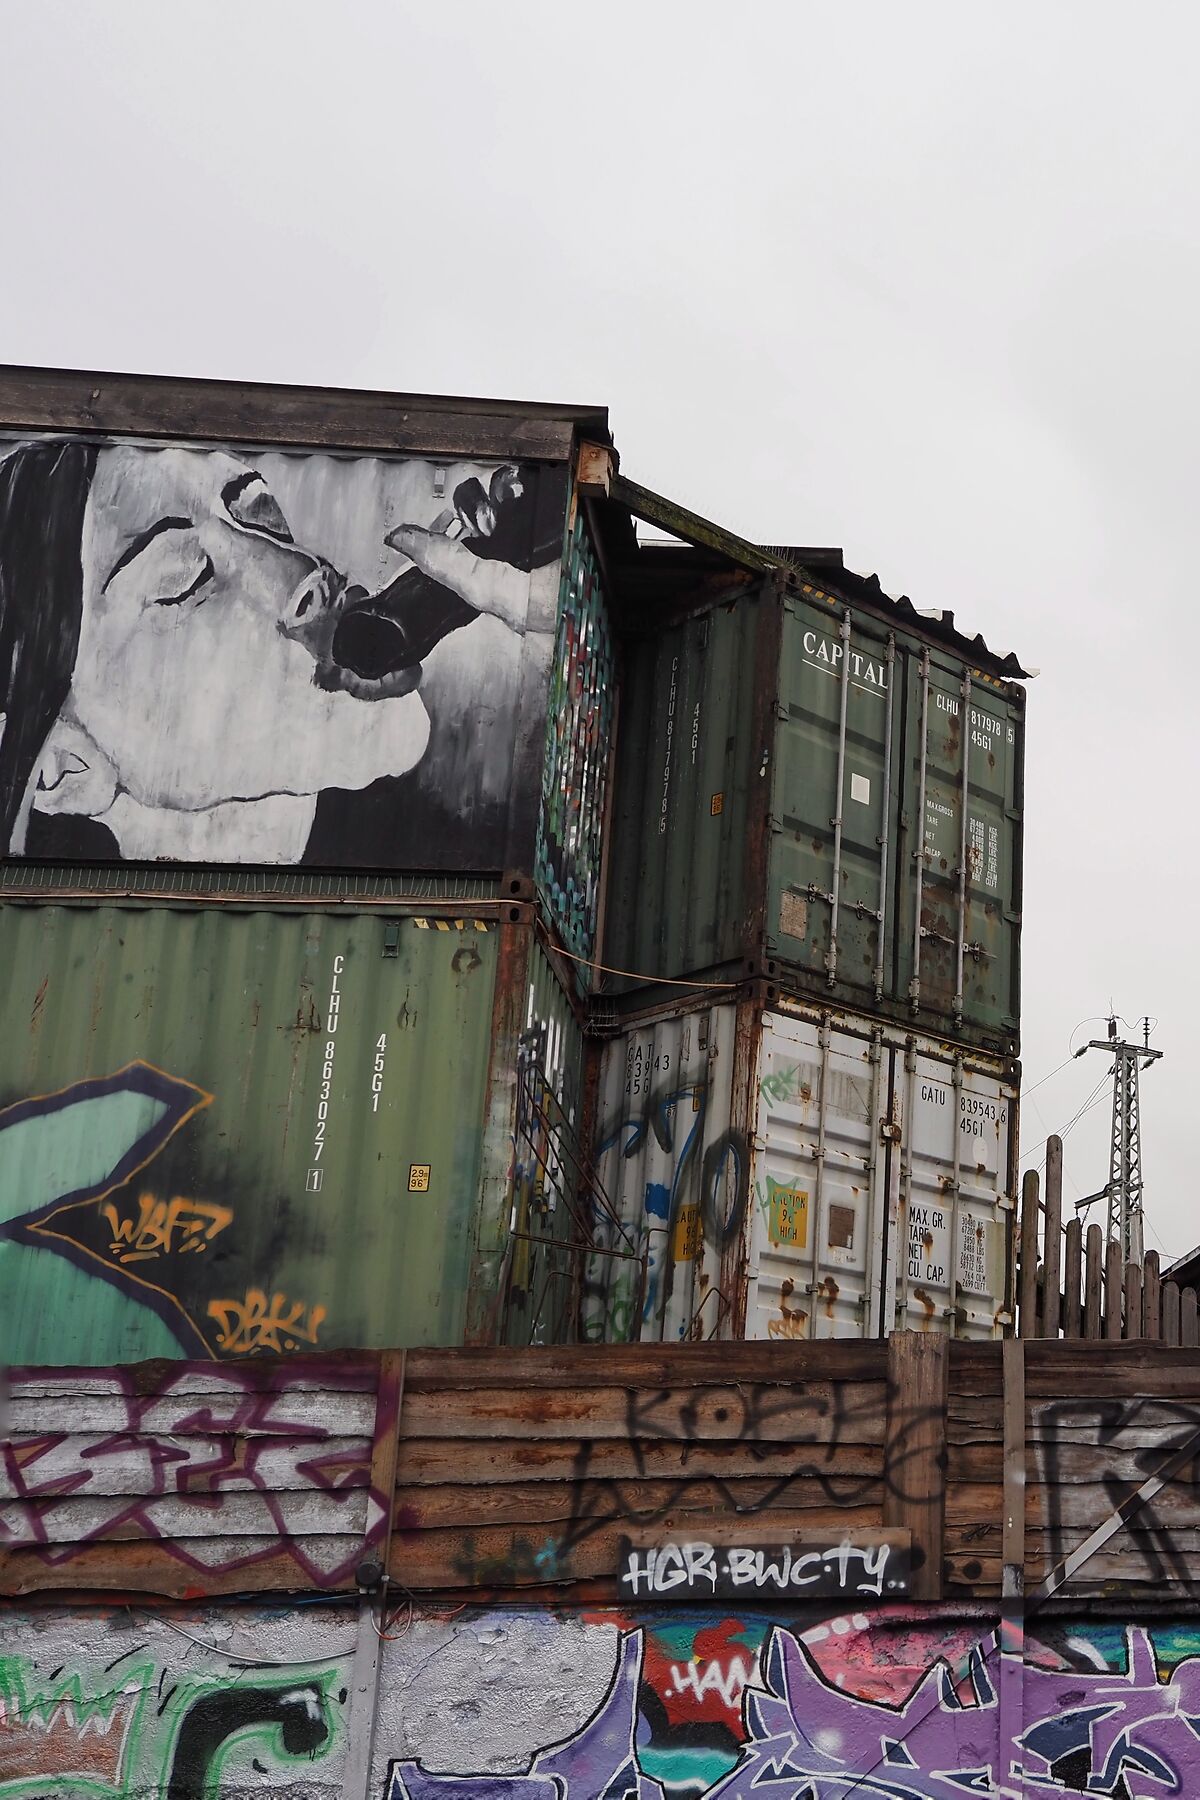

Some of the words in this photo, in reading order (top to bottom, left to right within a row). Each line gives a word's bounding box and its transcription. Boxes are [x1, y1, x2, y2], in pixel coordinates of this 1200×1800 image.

[669, 657, 678, 717] CLHU
[937, 694, 958, 716] CLHU
[971, 710, 1001, 736] 817978
[971, 730, 992, 751] 45G1
[661, 720, 673, 813] 817978
[925, 830, 936, 841] NET
[327, 955, 344, 1033] CLHU
[372, 1033, 387, 1112] 45G1
[314, 1041, 335, 1162] 863027
[921, 1085, 946, 1106] GATU
[960, 1096, 996, 1121] 839543
[960, 1117, 983, 1138] 45G1
[909, 1206, 930, 1227] MAX.
[932, 1211, 946, 1230] GR.
[908, 1242, 923, 1261] NET
[908, 1260, 921, 1278] CU.
[926, 1263, 946, 1284] CAP.
